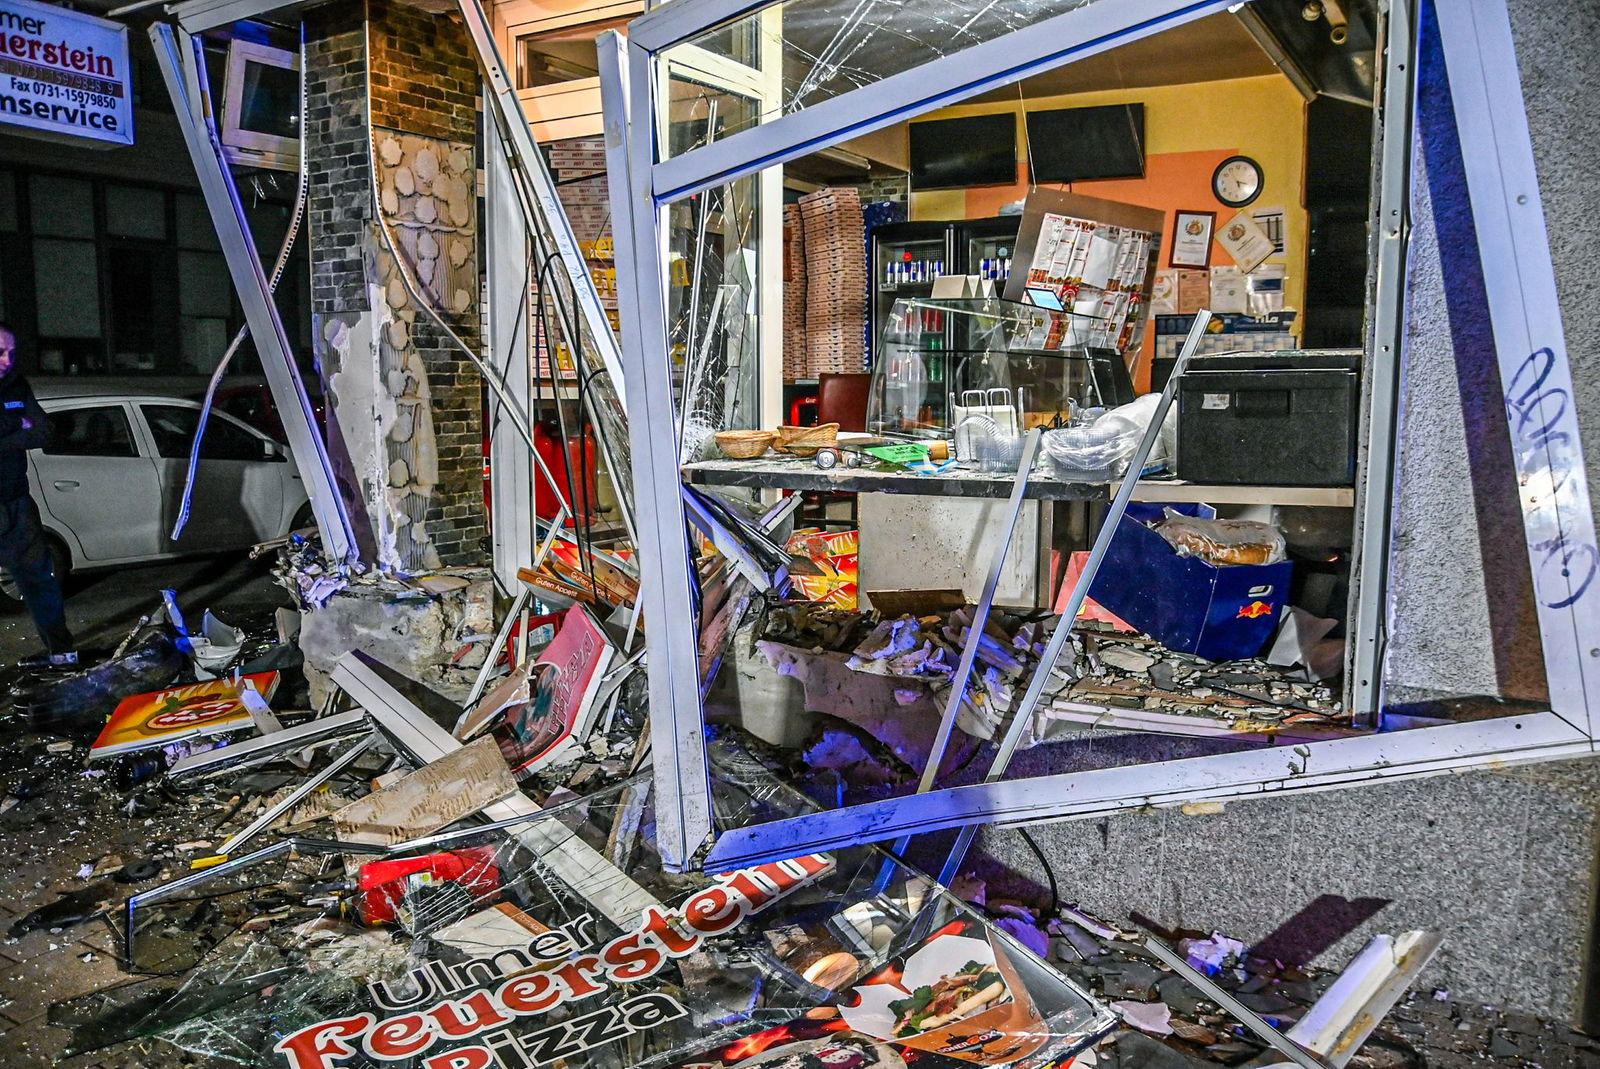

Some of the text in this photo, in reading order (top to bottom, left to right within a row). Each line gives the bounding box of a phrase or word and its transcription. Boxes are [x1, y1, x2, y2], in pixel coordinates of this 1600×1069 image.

[0, 92, 118, 131] nservice
[11, 77, 116, 110] Fax 0731-15979850
[535, 577, 555, 589] Guten
[273, 853, 837, 1069] Feuerstein
[367, 912, 595, 1010] Ulmer
